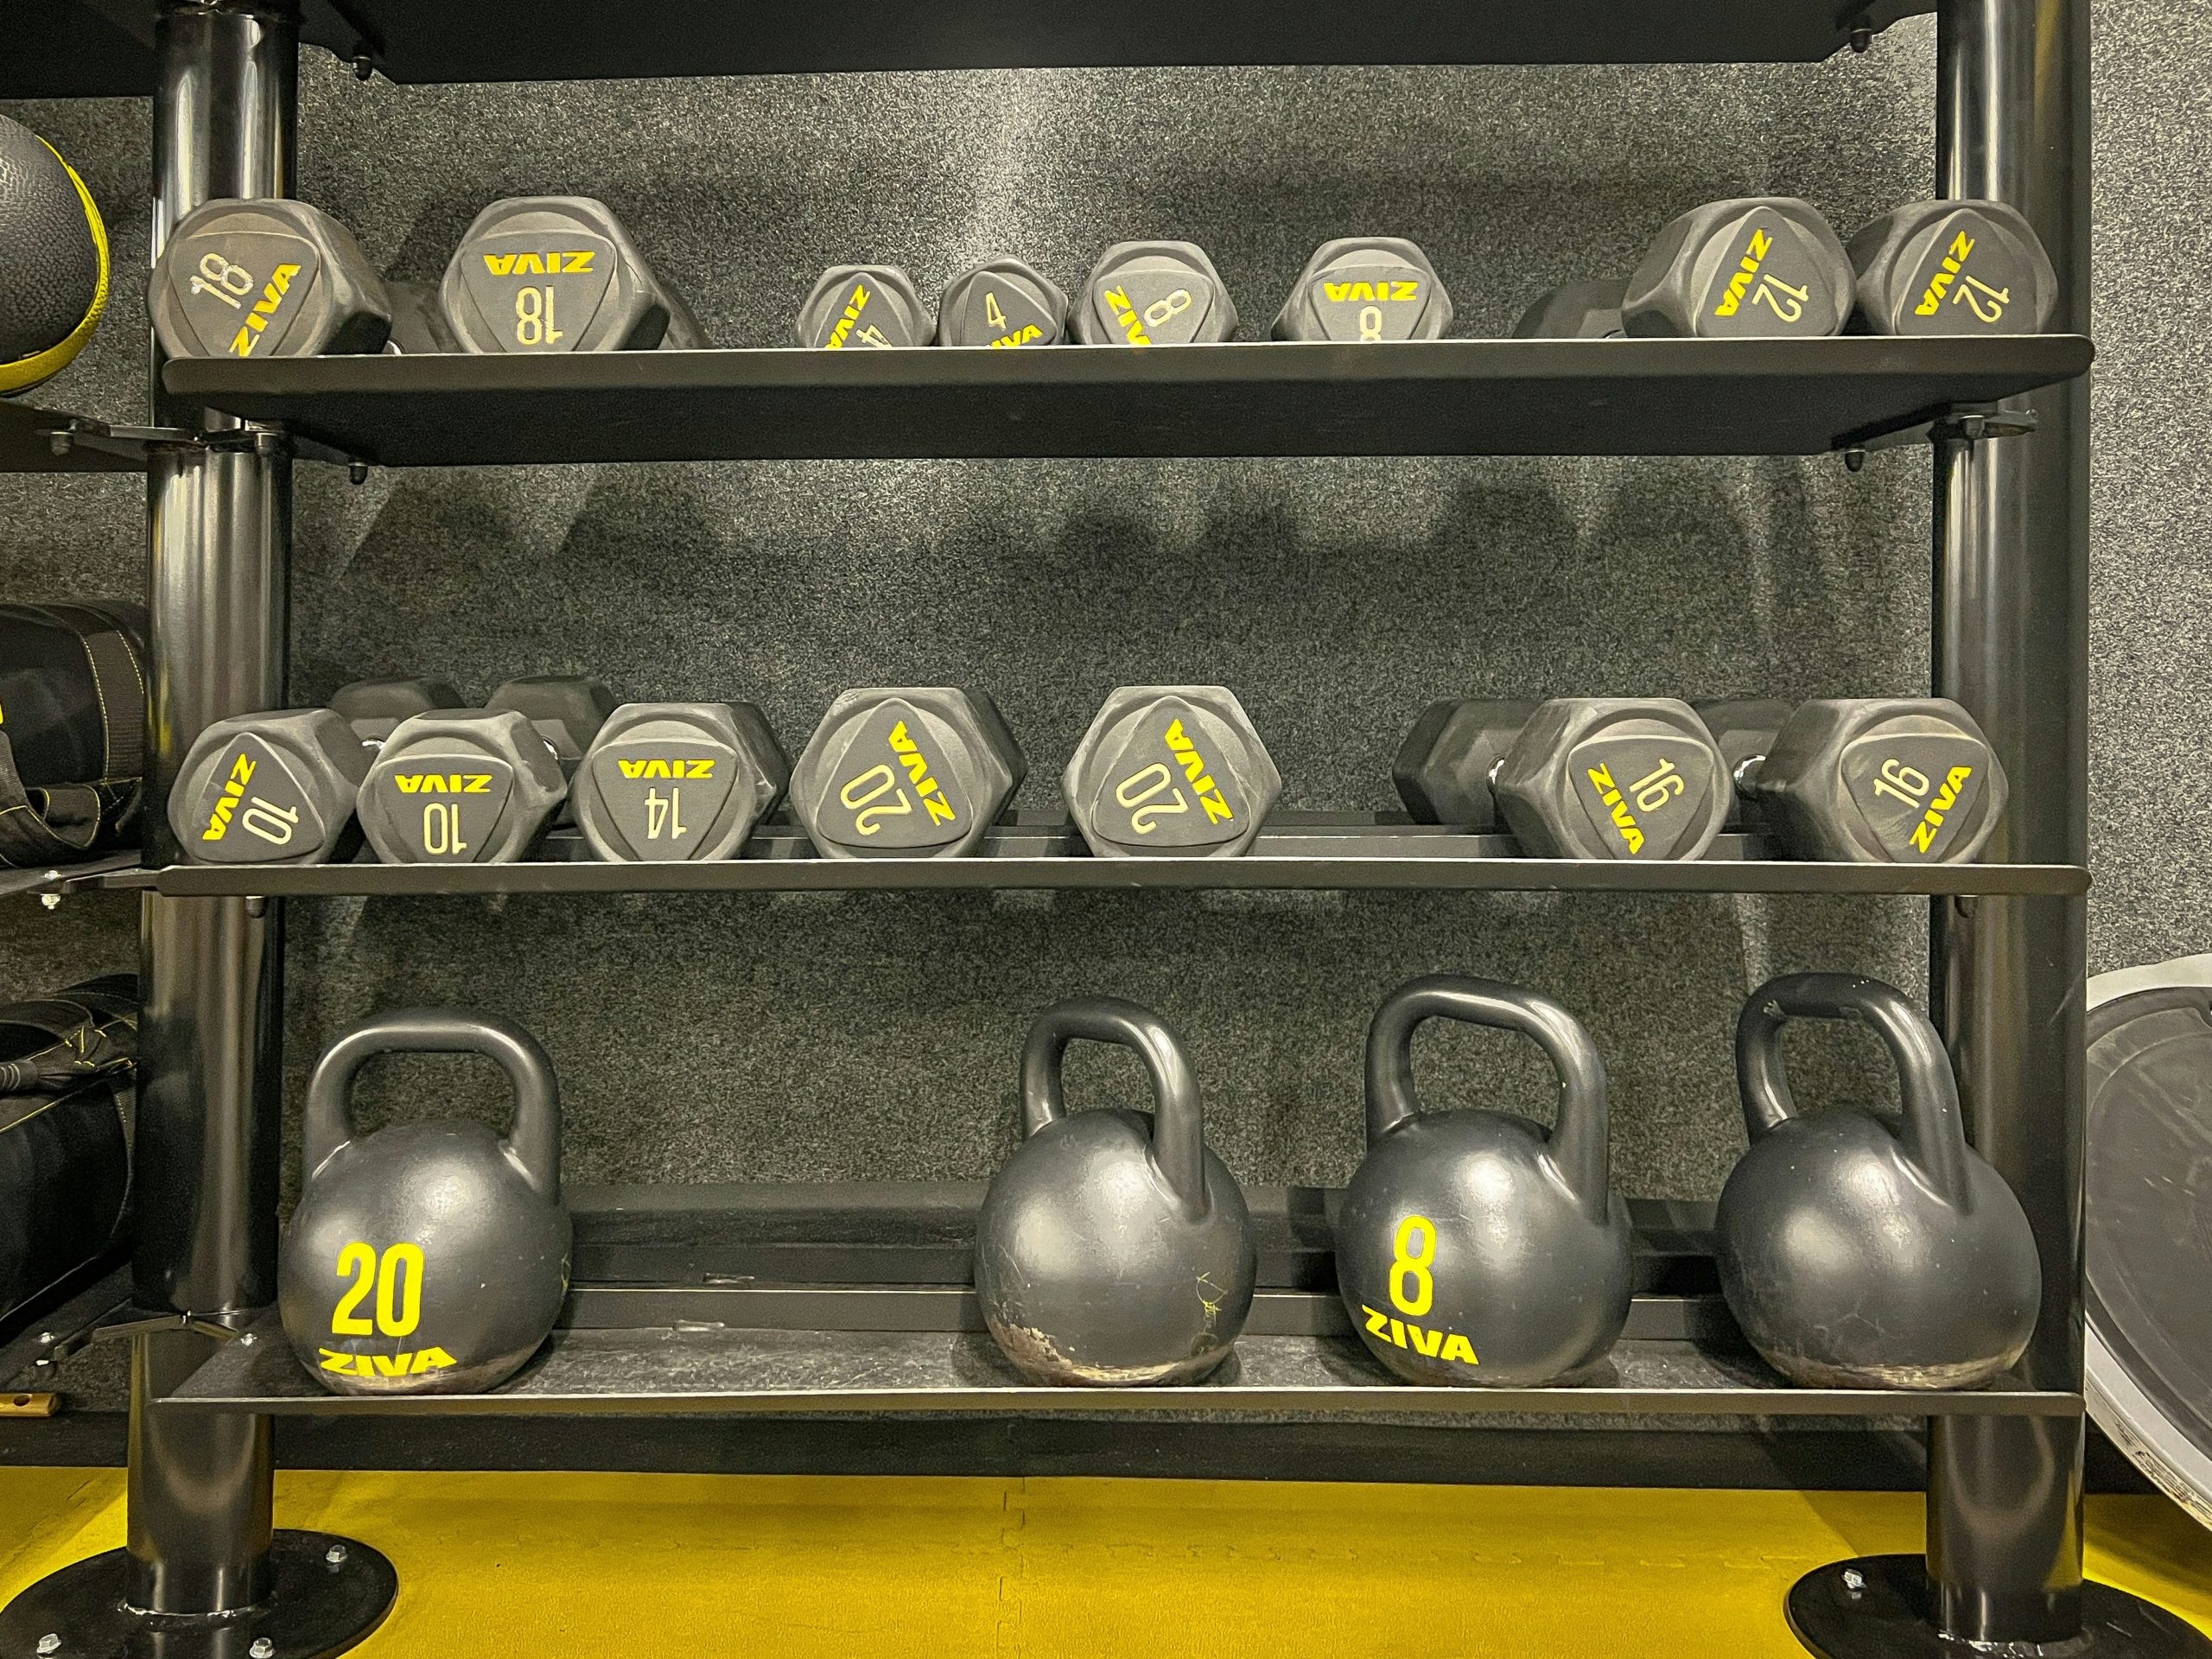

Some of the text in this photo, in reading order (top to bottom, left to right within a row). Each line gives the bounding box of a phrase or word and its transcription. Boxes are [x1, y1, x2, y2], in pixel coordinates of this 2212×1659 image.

[189, 253, 254, 310] 18
[483, 251, 595, 276] ZIVA
[1323, 281, 1419, 302] ZIVA
[1713, 228, 1773, 317] ZIVA
[1914, 230, 1975, 316] ZIVA
[228, 263, 302, 358] ZIVA
[516, 285, 563, 345] 18
[985, 291, 1007, 331] 4
[1104, 283, 1152, 346] ZIV
[1143, 288, 1192, 327] 8
[1751, 273, 1809, 323] 12
[1952, 275, 2011, 324] 12
[201, 753, 257, 841] ZIVA
[394, 773, 493, 793] ZIVA
[617, 759, 716, 779] ZIVA
[887, 720, 957, 827] ZIVA
[1164, 718, 1235, 825] ZIVA
[1629, 758, 1685, 813] 16
[1873, 758, 1930, 809] 16
[241, 796, 299, 846] 10
[644, 786, 688, 840] 14
[840, 764, 913, 836] 20
[1116, 762, 1190, 835] 20
[1587, 762, 1645, 855] ZIVA
[1908, 766, 1973, 855] ZIVA
[423, 802, 467, 855] 10
[332, 1241, 426, 1338] 20
[1389, 1215, 1438, 1317] 8
[318, 1345, 458, 1377] ZIVA
[1361, 1304, 1480, 1365] ZIVA
